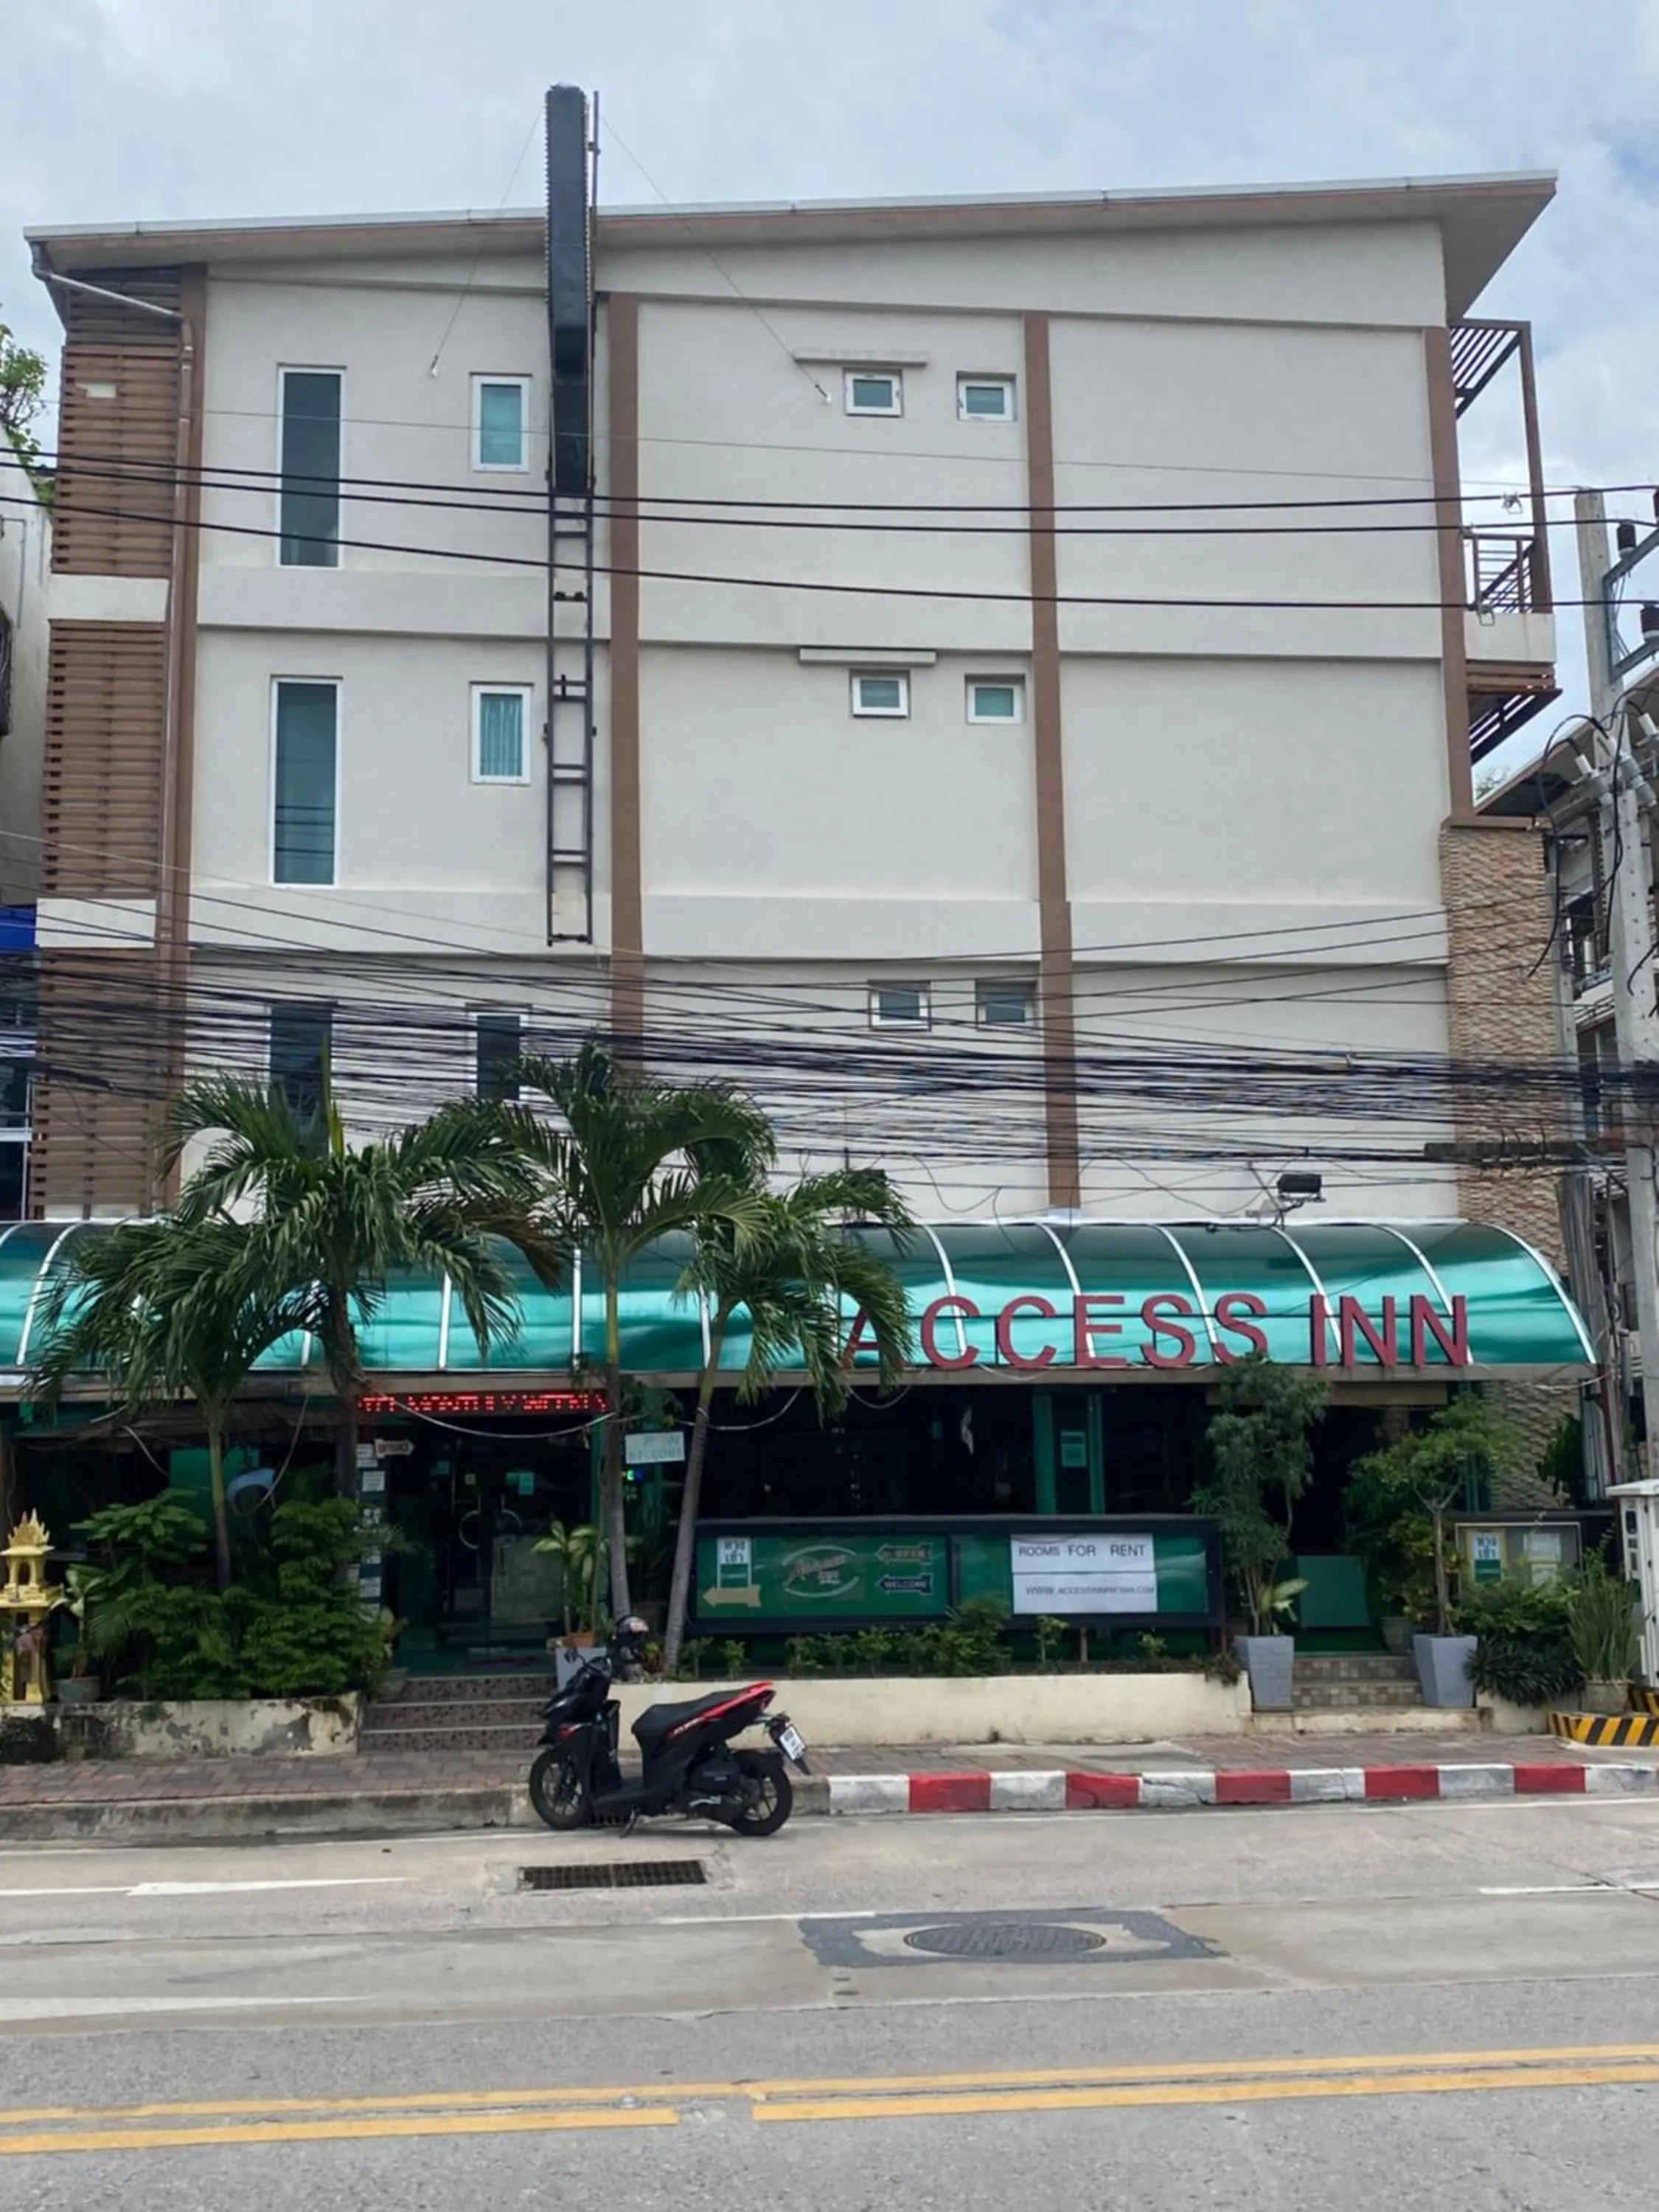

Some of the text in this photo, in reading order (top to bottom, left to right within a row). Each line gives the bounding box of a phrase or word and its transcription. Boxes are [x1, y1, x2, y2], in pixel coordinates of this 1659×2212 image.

[838, 1293, 1467, 1370] ACCESS INN
[1018, 1544, 1145, 1558] ROOMS FOR RENT
